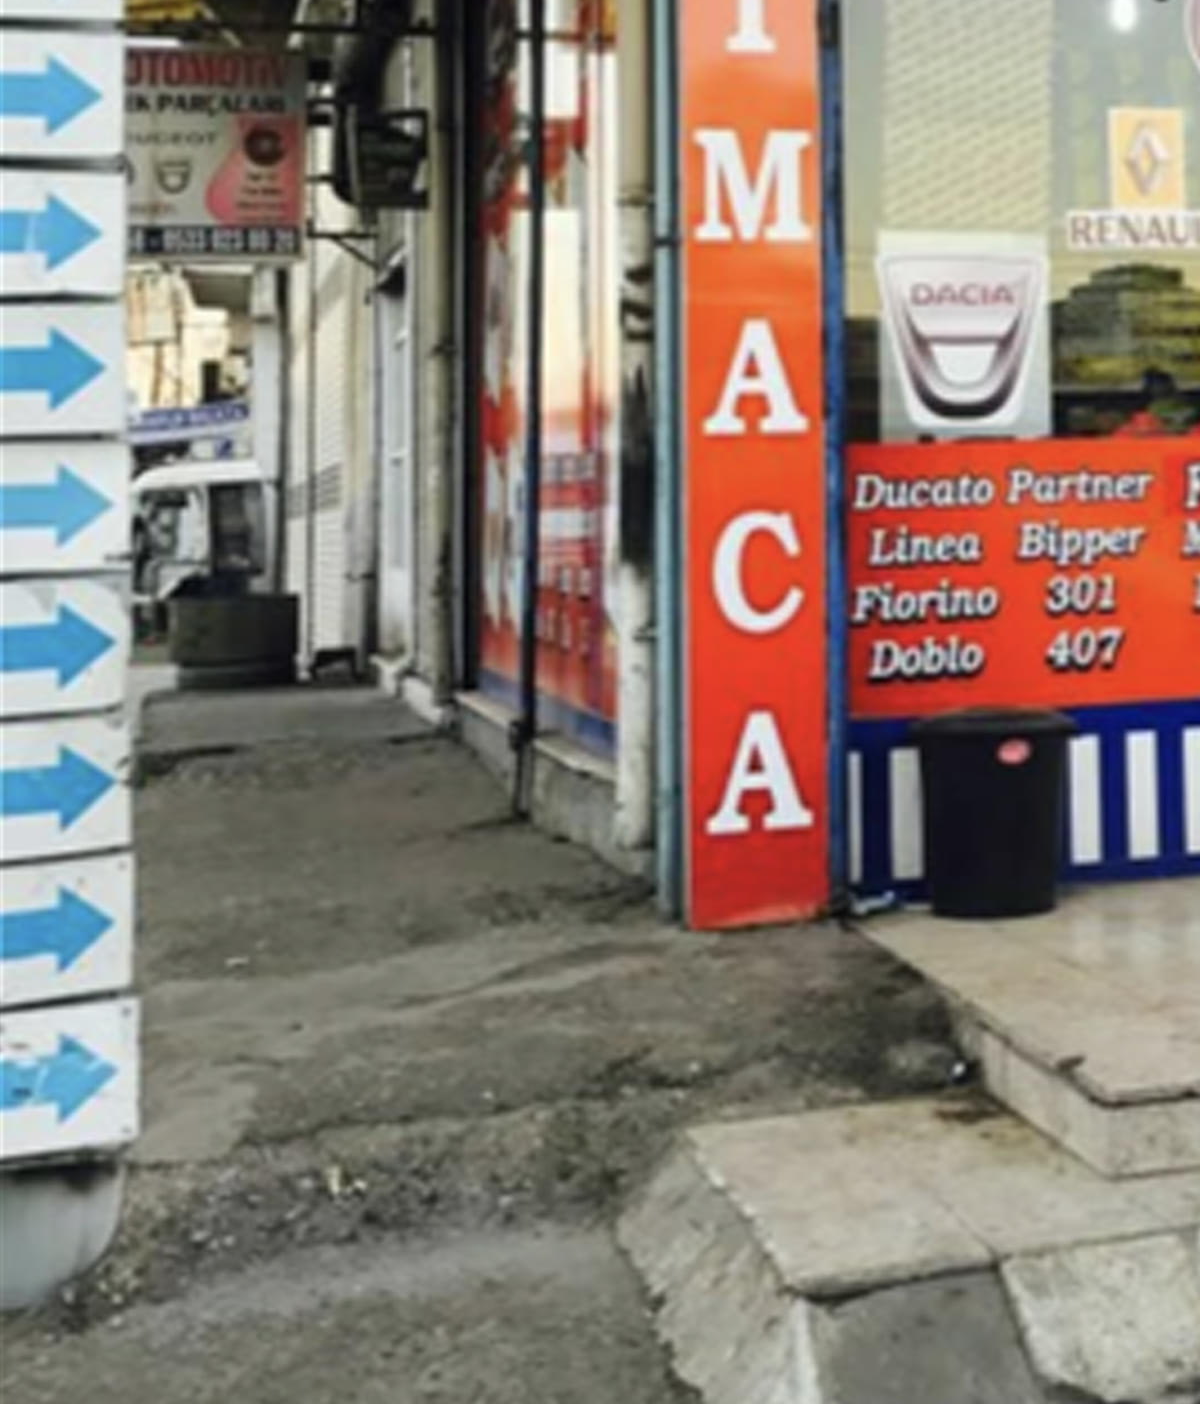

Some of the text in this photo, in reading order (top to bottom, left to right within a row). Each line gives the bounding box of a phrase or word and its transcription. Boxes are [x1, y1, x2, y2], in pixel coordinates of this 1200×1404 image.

[909, 281, 1015, 307] DACIA
[853, 472, 995, 510] Ducato
[1006, 467, 1152, 504] Partner
[868, 525, 982, 566] Linea
[1016, 520, 1147, 567] Bipper
[850, 578, 999, 625] Fiorino
[1044, 574, 1117, 613] 301
[869, 634, 985, 680] Doblo
[1045, 627, 1123, 670] 407
